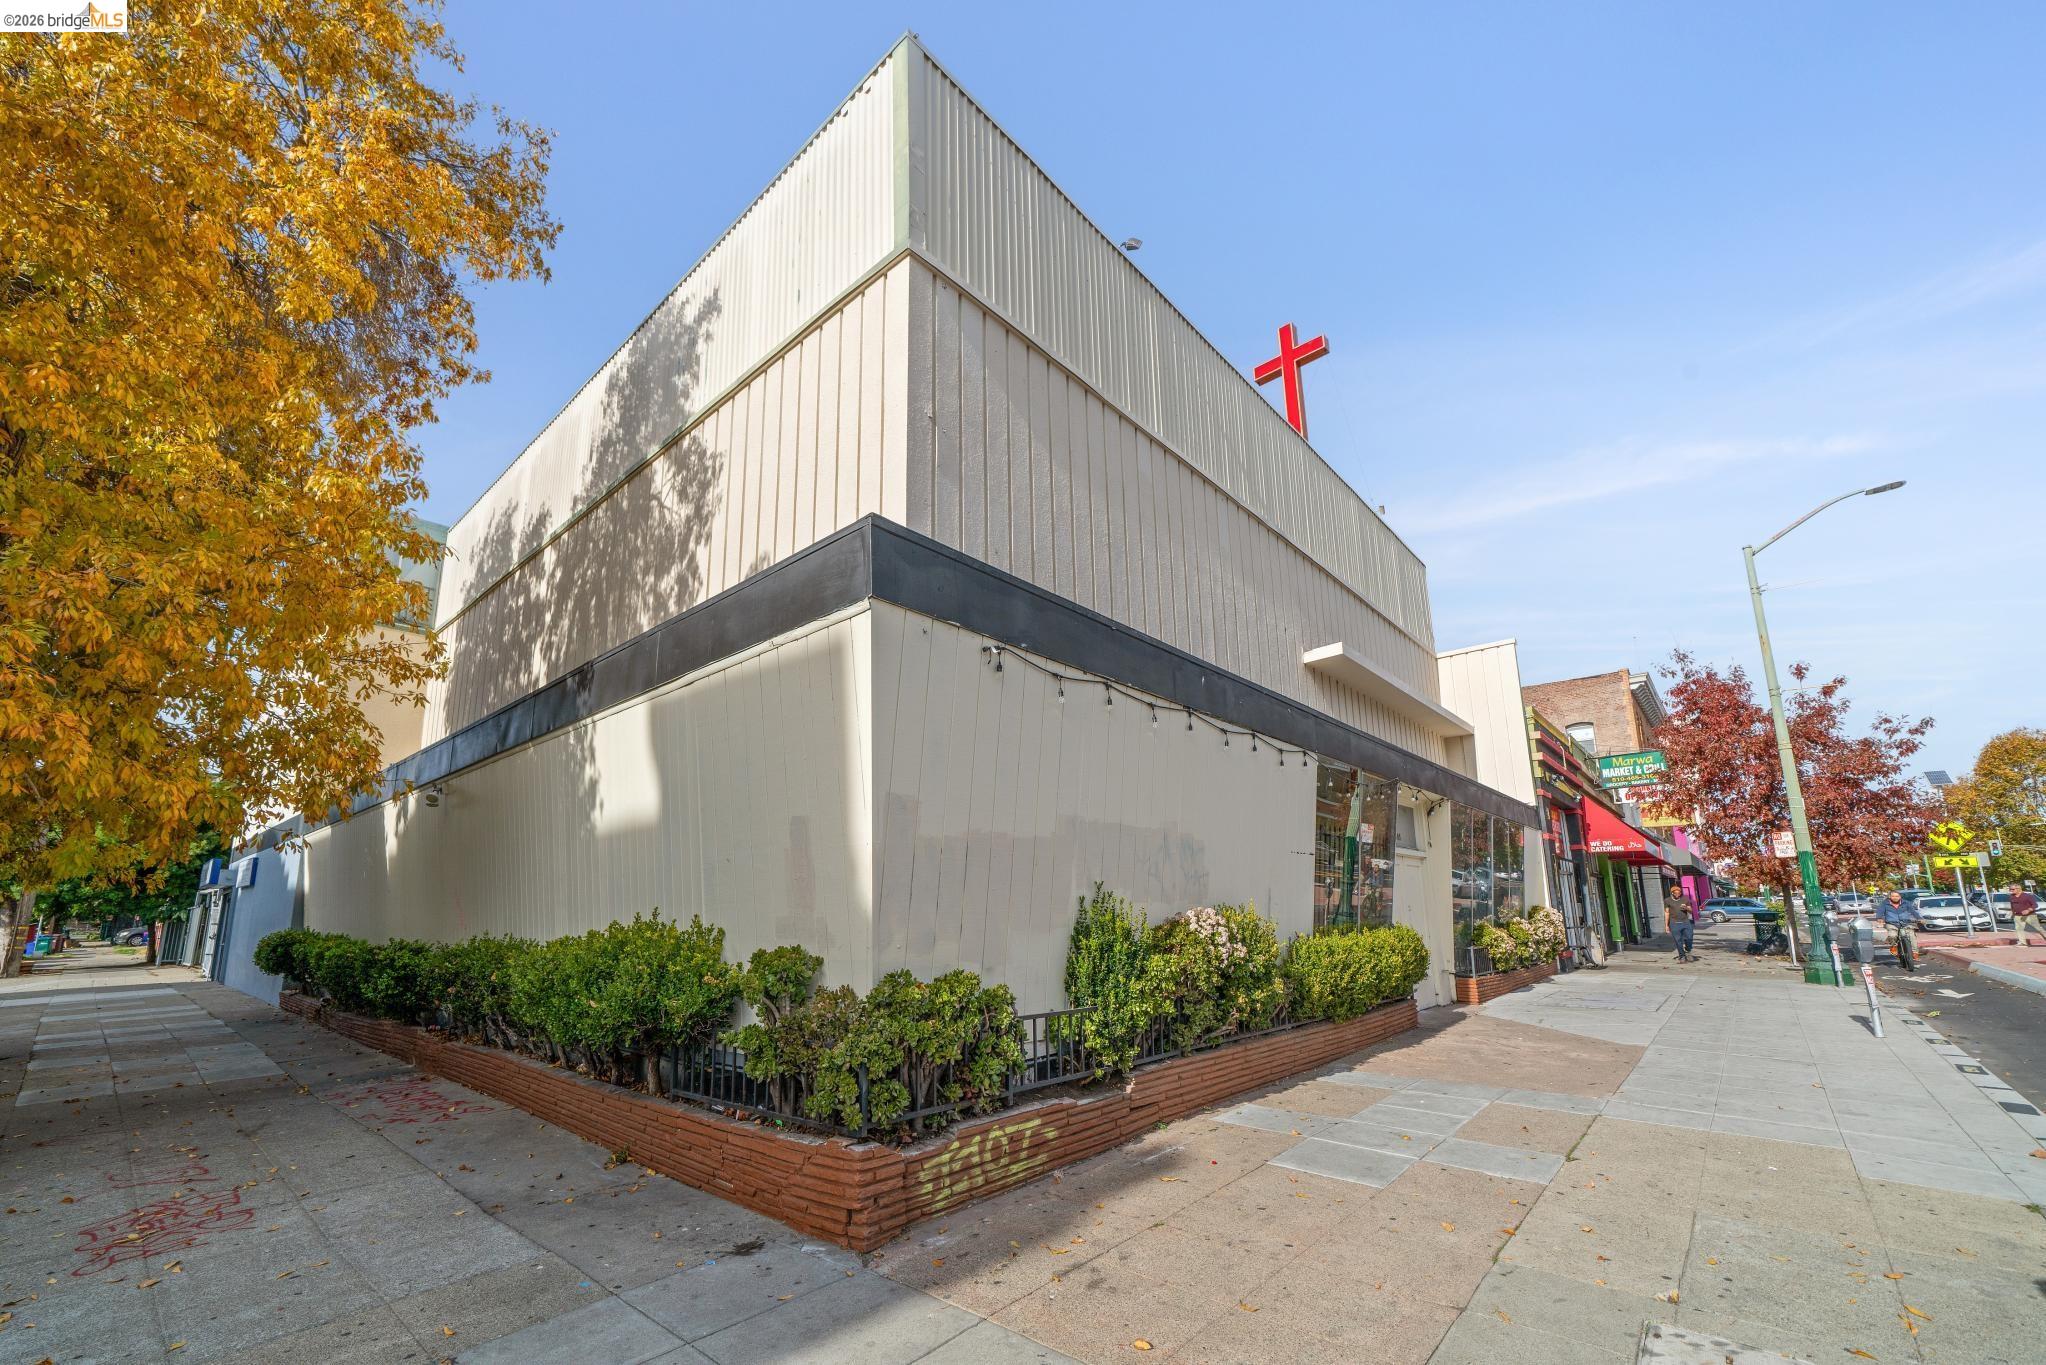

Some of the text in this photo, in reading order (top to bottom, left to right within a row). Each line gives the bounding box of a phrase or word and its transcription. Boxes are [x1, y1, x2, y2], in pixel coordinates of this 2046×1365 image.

[1612, 756, 1653, 767] Marwa
[1602, 766, 1634, 778] MARKET
[1635, 765, 1642, 775] &
